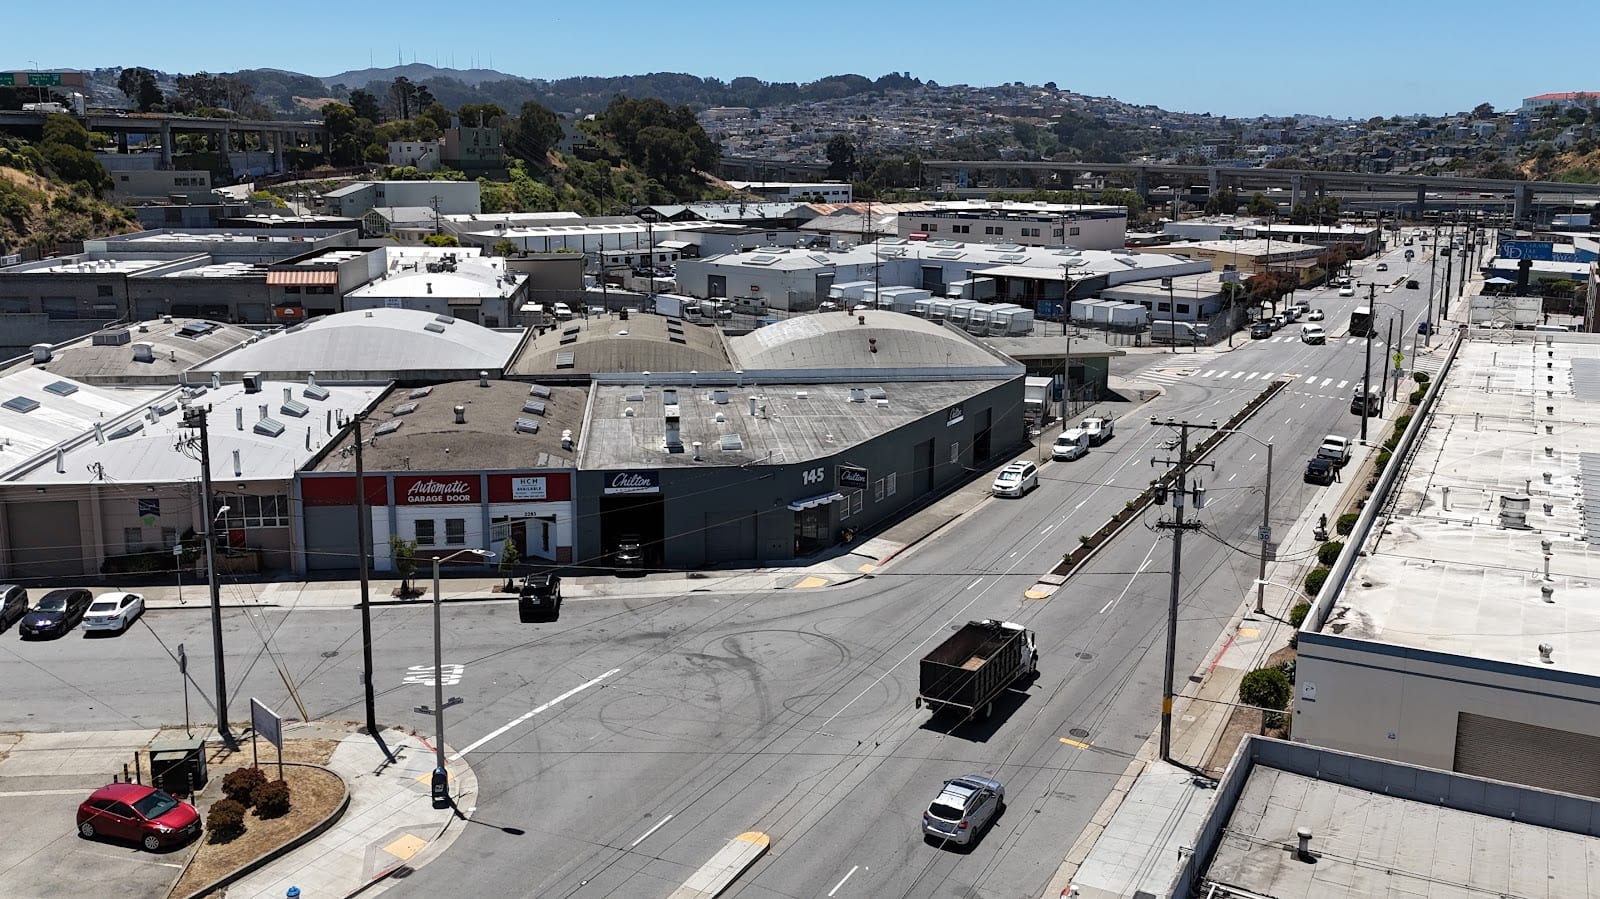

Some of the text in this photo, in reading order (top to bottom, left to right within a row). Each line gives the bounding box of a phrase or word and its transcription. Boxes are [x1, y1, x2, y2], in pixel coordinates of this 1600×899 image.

[612, 472, 651, 487] Chilton
[802, 467, 825, 485] 145
[841, 470, 866, 482] Chilton
[407, 479, 471, 495] Automatic
[407, 494, 471, 503] GARAGE DOOR
